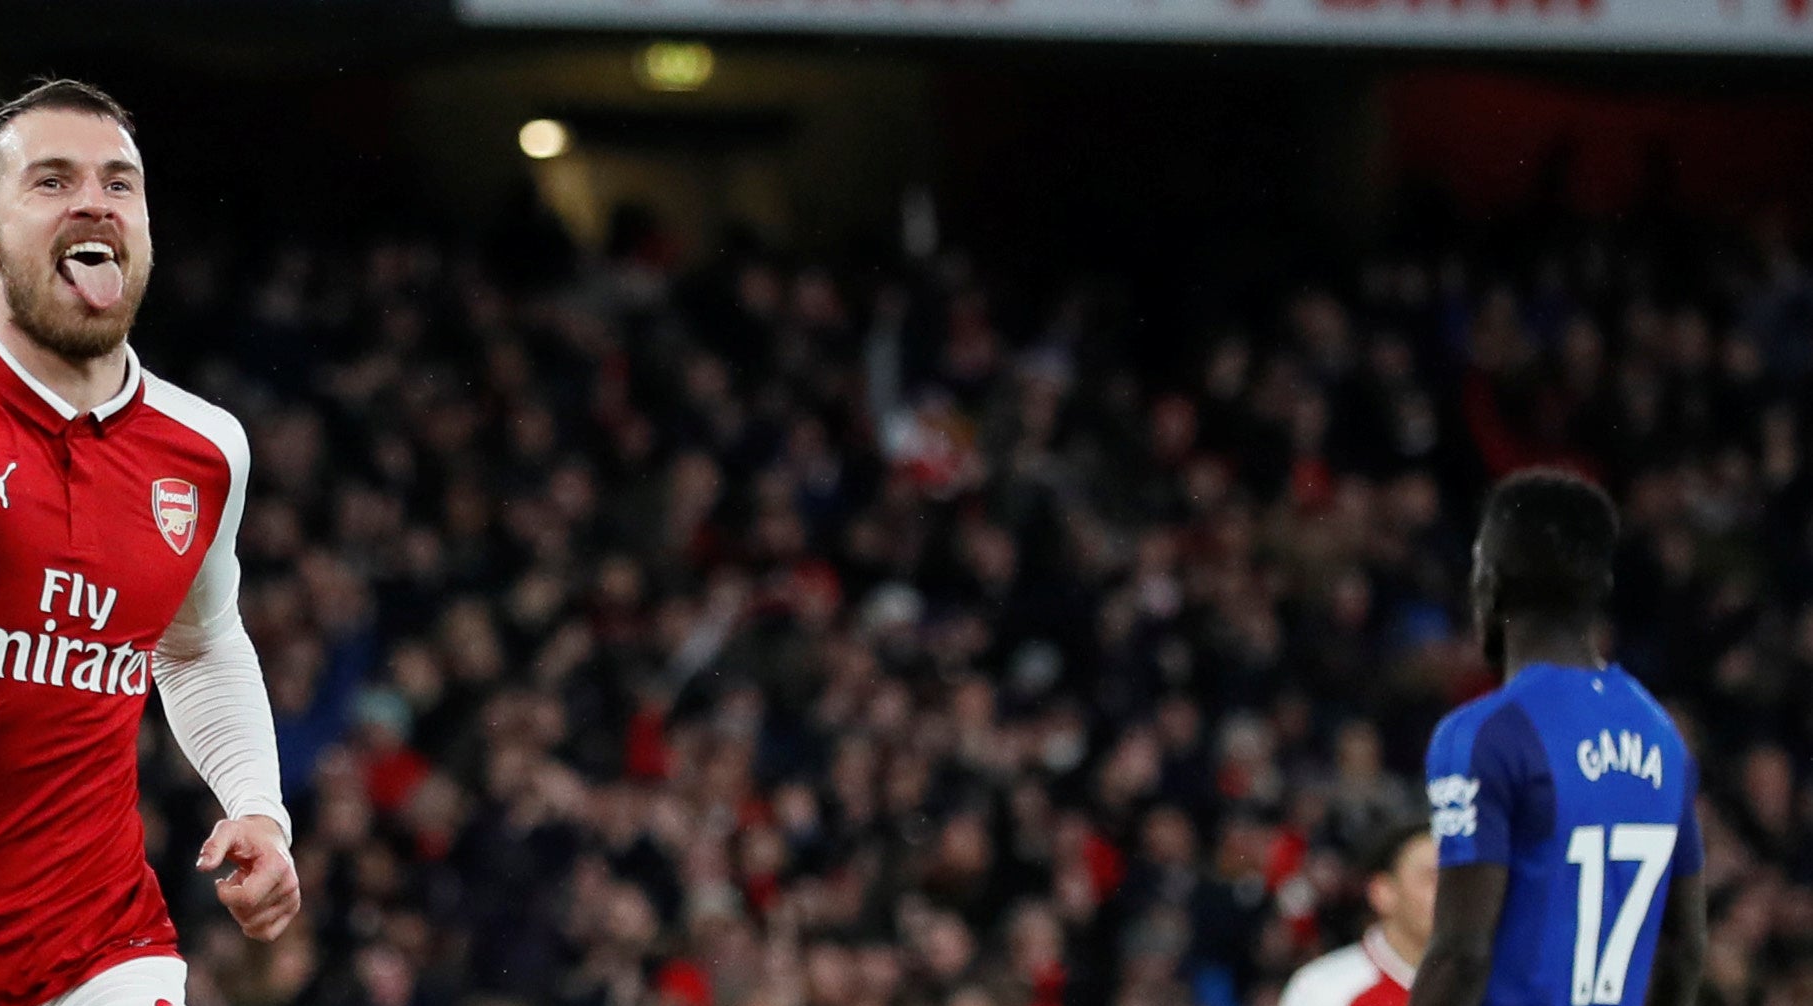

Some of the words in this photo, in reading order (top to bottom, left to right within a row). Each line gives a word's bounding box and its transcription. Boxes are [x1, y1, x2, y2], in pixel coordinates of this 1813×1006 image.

[159, 489, 192, 506] Arsenal
[40, 567, 118, 631] Fly
[1576, 728, 1663, 790] GANA
